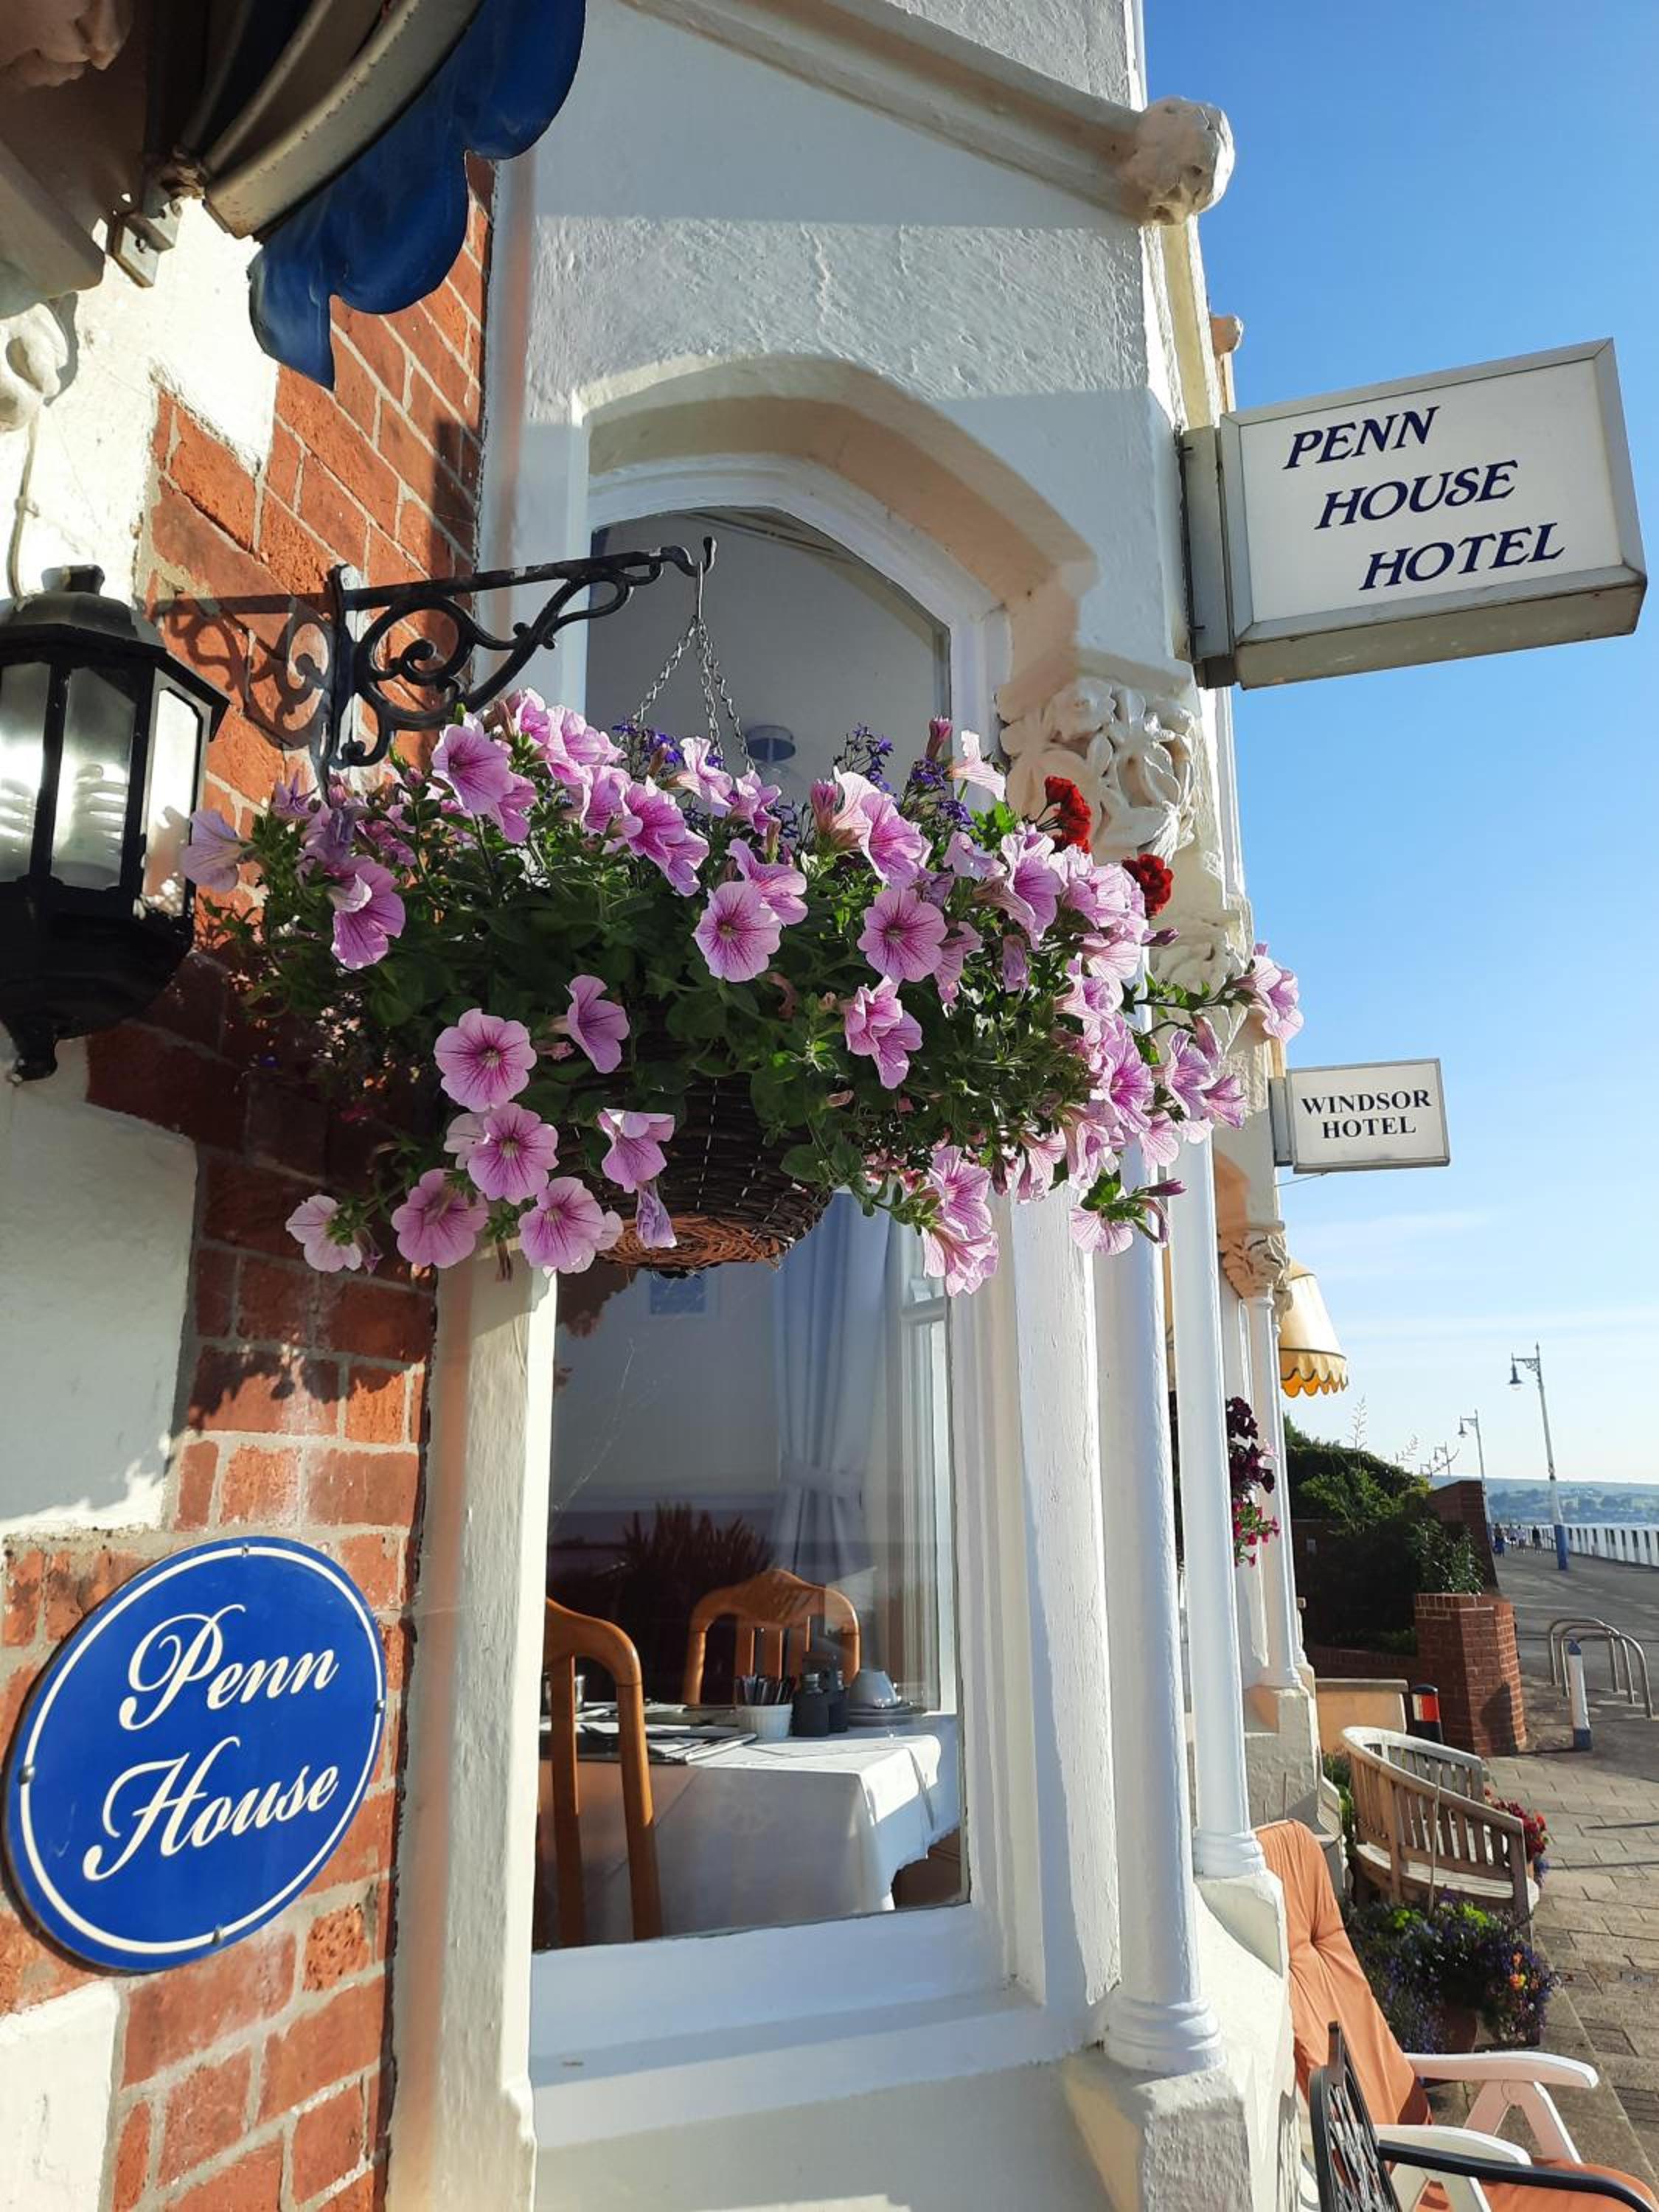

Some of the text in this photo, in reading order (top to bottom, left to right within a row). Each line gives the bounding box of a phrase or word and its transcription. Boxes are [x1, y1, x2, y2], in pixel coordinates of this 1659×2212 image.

[1283, 406, 1440, 470] PENN
[1315, 460, 1518, 529] HOUSE
[1359, 523, 1565, 591] HOTEL
[1301, 1089, 1432, 1115] WINDSOR
[1321, 1116, 1416, 1139] HOTEL
[119, 1604, 338, 1731] Penn
[82, 1736, 338, 1882] House
